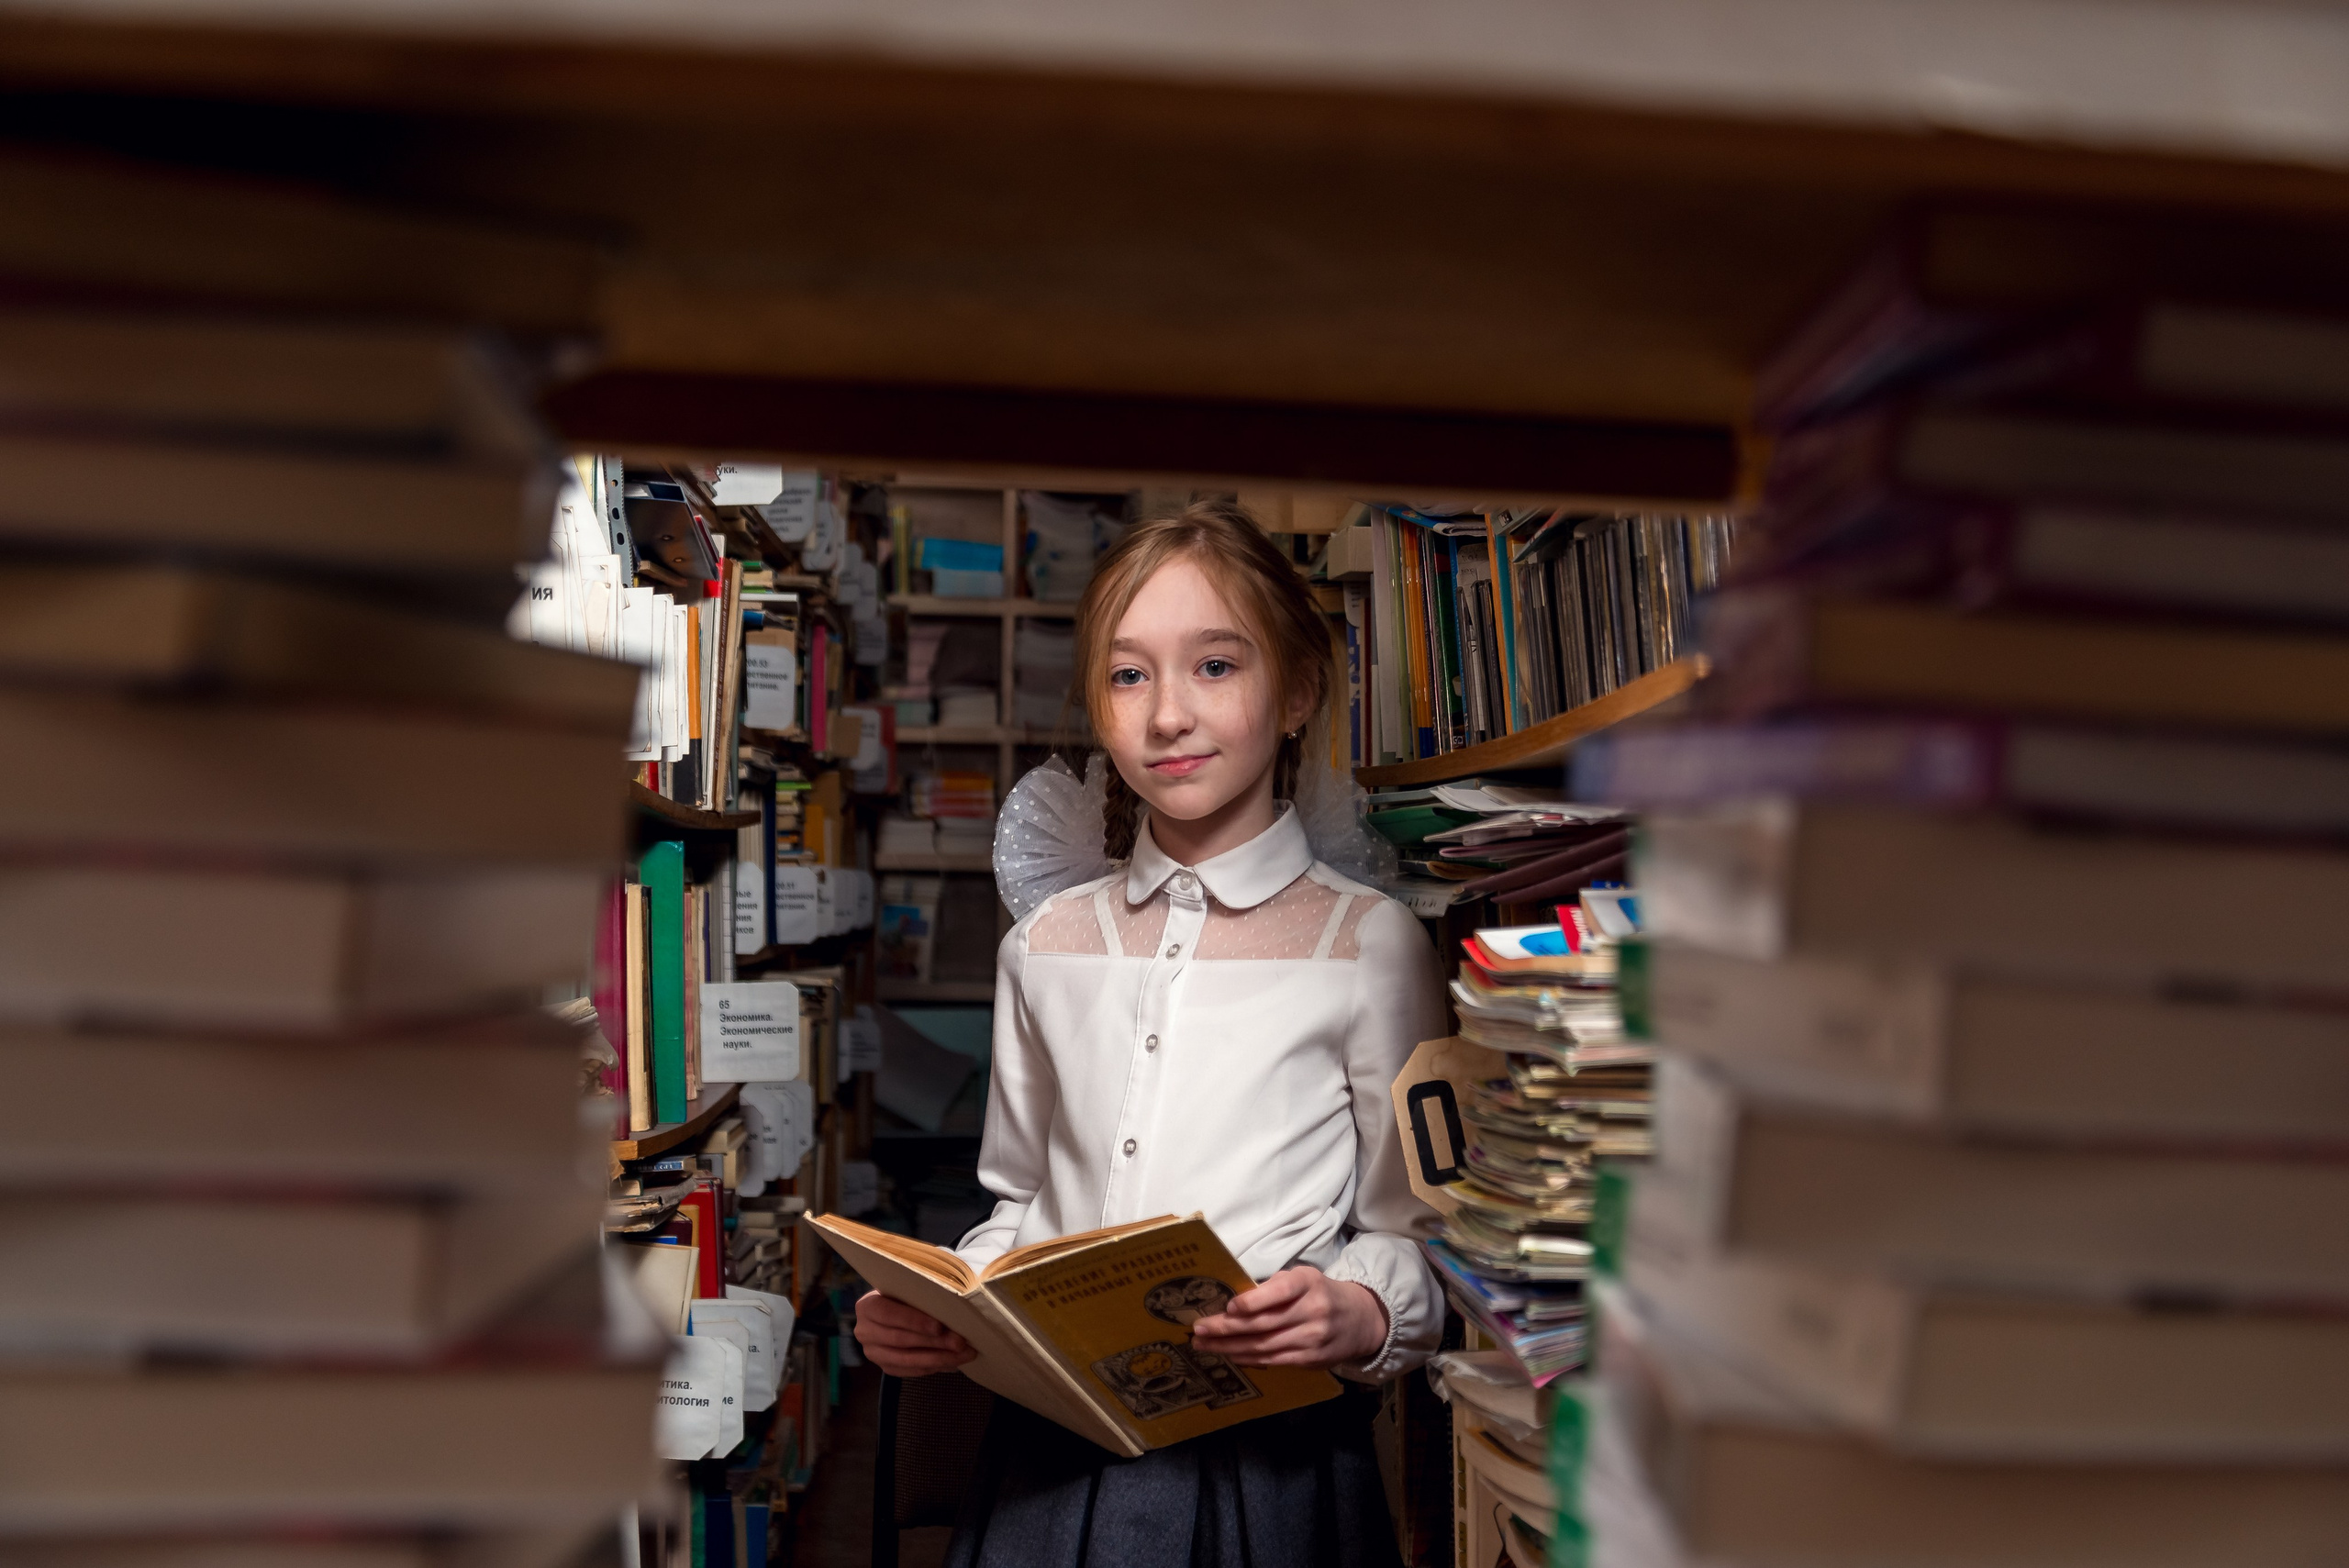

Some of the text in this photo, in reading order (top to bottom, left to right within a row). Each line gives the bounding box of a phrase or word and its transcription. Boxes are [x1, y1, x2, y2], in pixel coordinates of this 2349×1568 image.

[718, 1000, 729, 1009] 65
[719, 1014, 774, 1023] Экономика.
[719, 1027, 793, 1036] Экономические
[722, 1041, 752, 1051] науки.
[1022, 1268, 1108, 1303] ПРОВЕДЕНИЕ
[1111, 1243, 1200, 1273] ПРАЗДНИКОВ
[1059, 1276, 1133, 1304] НАЧАЛЬНЫХ
[1137, 1258, 1198, 1282] КЛАССАХ
